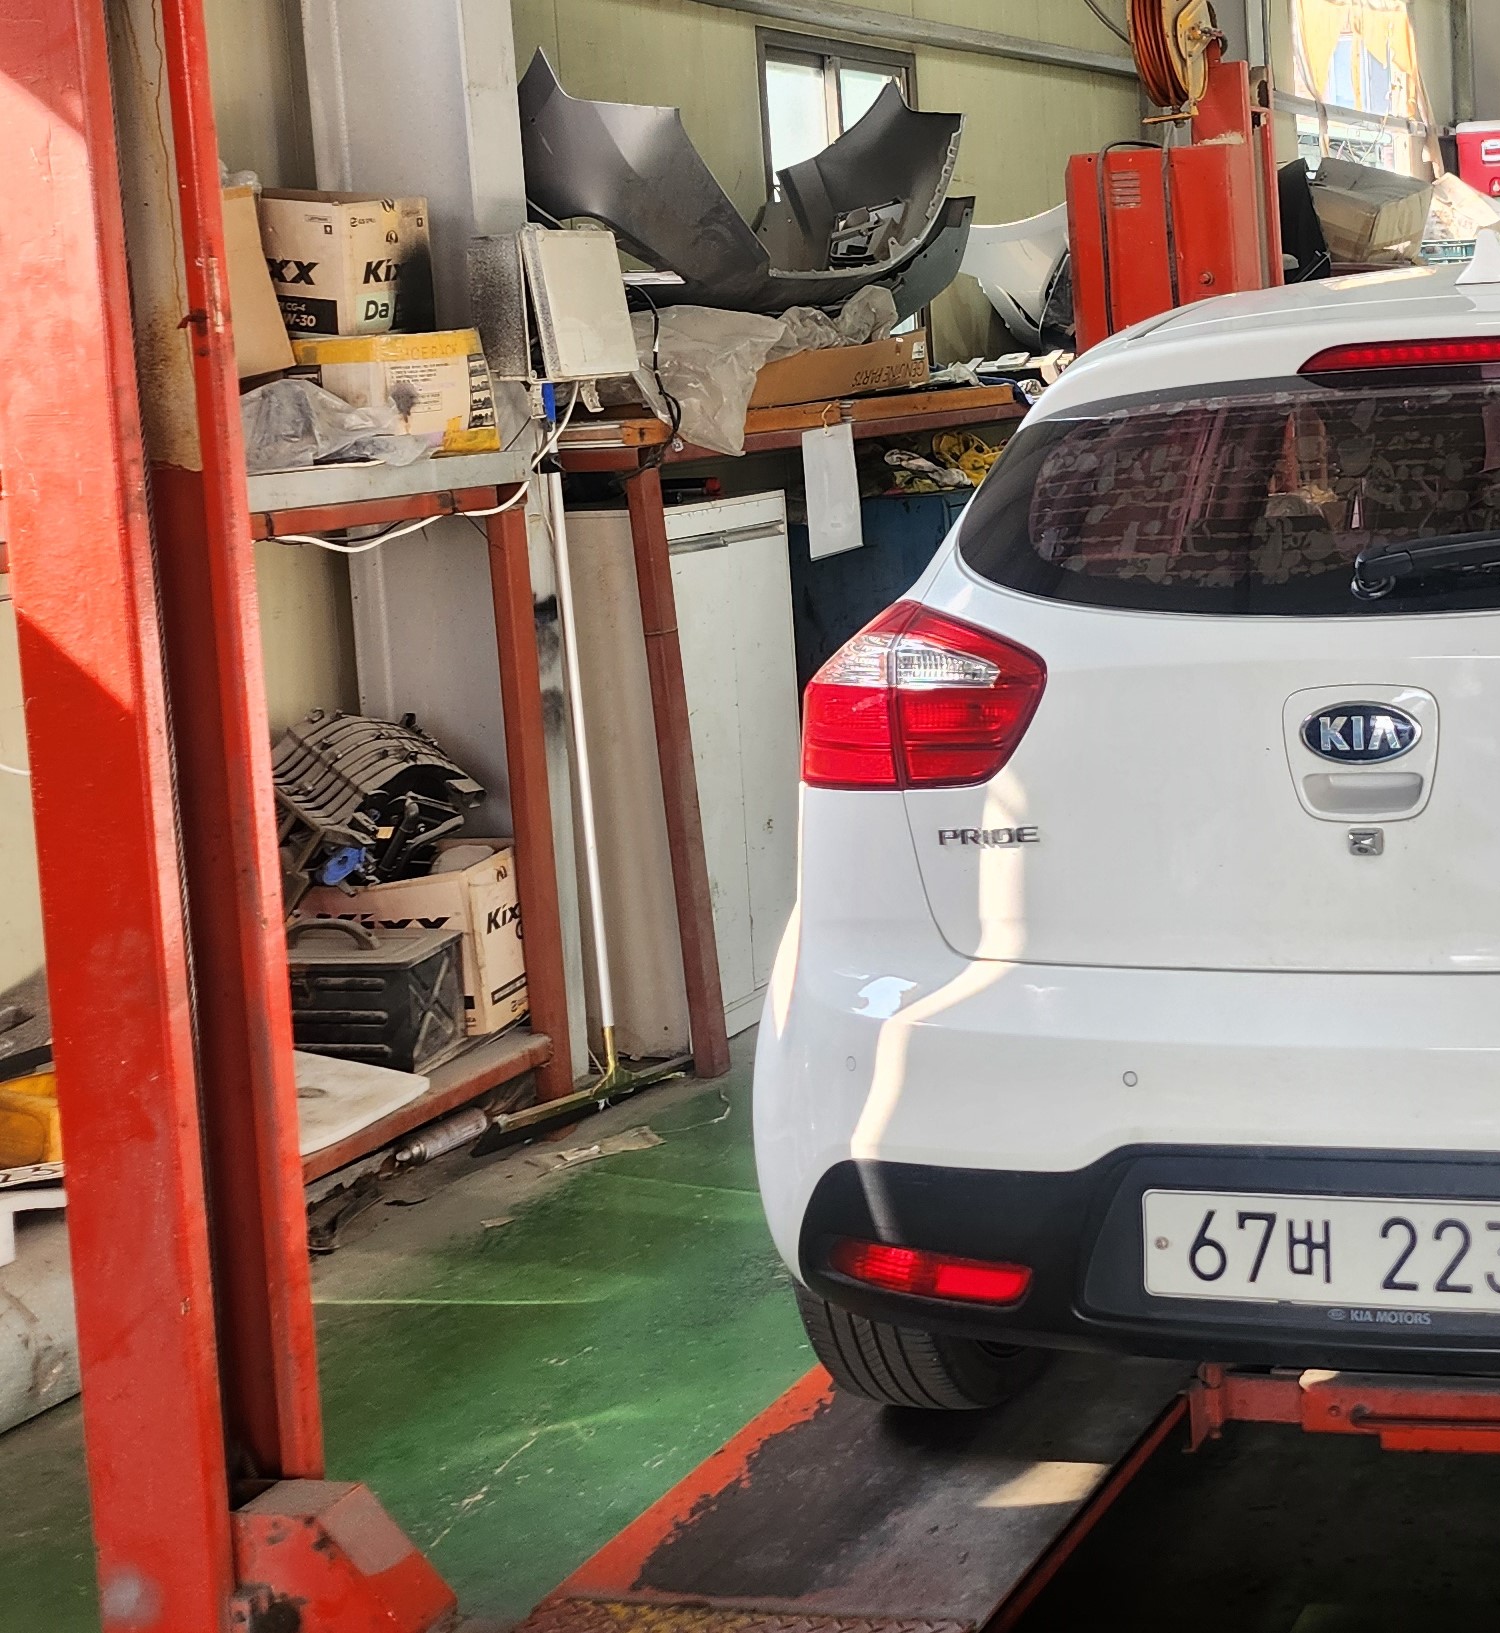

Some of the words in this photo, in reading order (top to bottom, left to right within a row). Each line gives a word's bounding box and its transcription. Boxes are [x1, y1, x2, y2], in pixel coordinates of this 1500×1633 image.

[1319, 715, 1401, 751] KIA
[938, 826, 1040, 845] PRIDE
[1188, 1209, 1332, 1285] 67버
[1350, 1309, 1373, 1322] KIA
[1376, 1311, 1432, 1325] MOTORS
